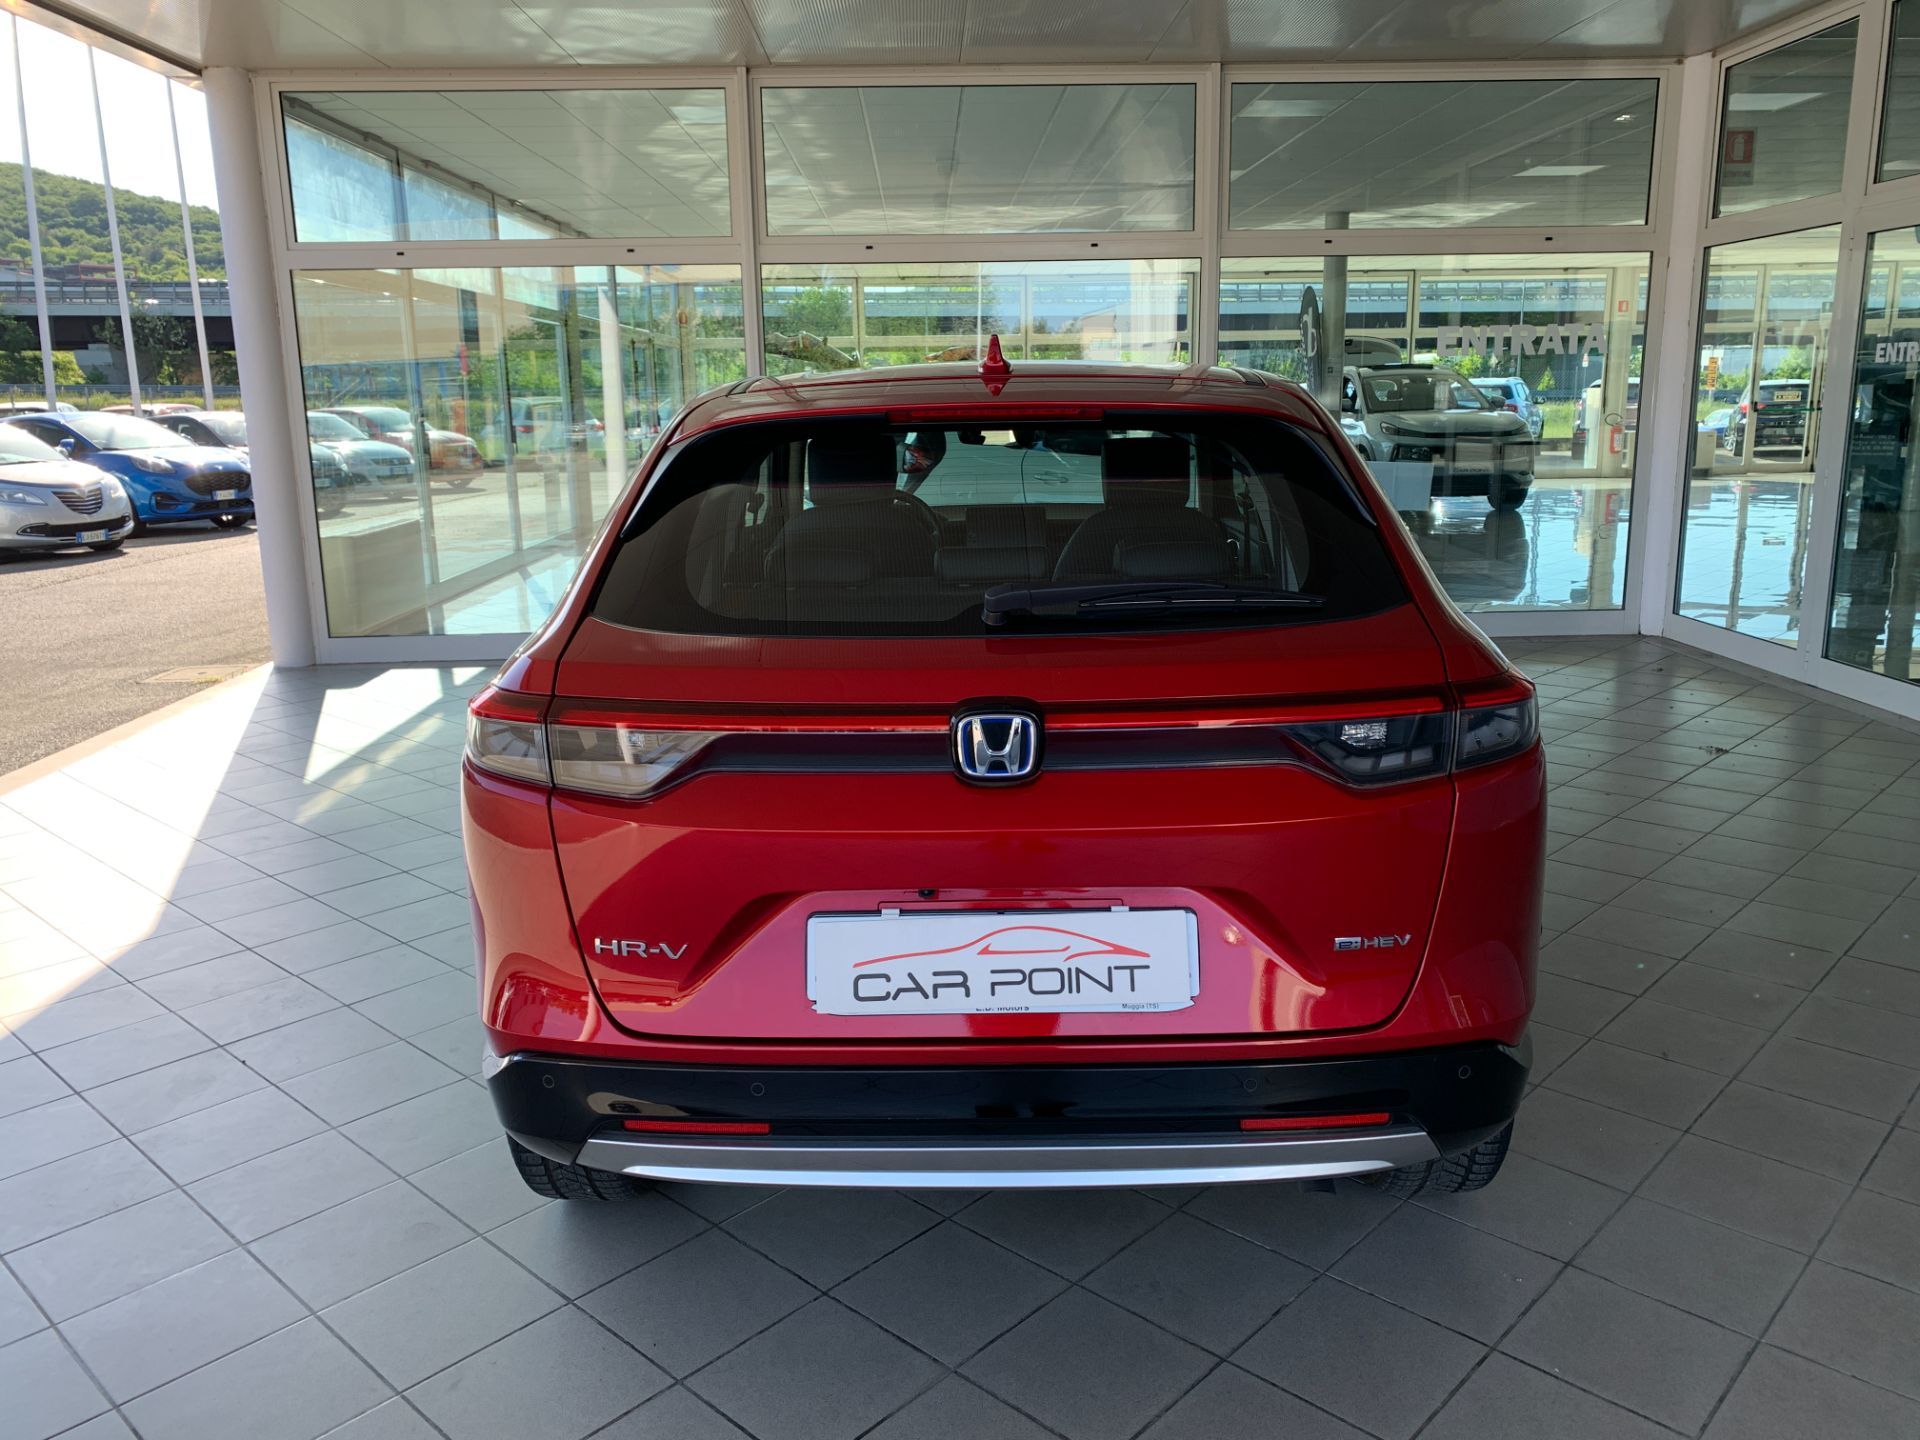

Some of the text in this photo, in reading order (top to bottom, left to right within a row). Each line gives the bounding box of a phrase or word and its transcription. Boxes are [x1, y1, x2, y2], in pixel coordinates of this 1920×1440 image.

[1437, 323, 1607, 356] ENTRATA
[1875, 341, 1920, 364] ENTR
[594, 937, 688, 960] HR-V
[853, 965, 1151, 1002] CAR POINT
